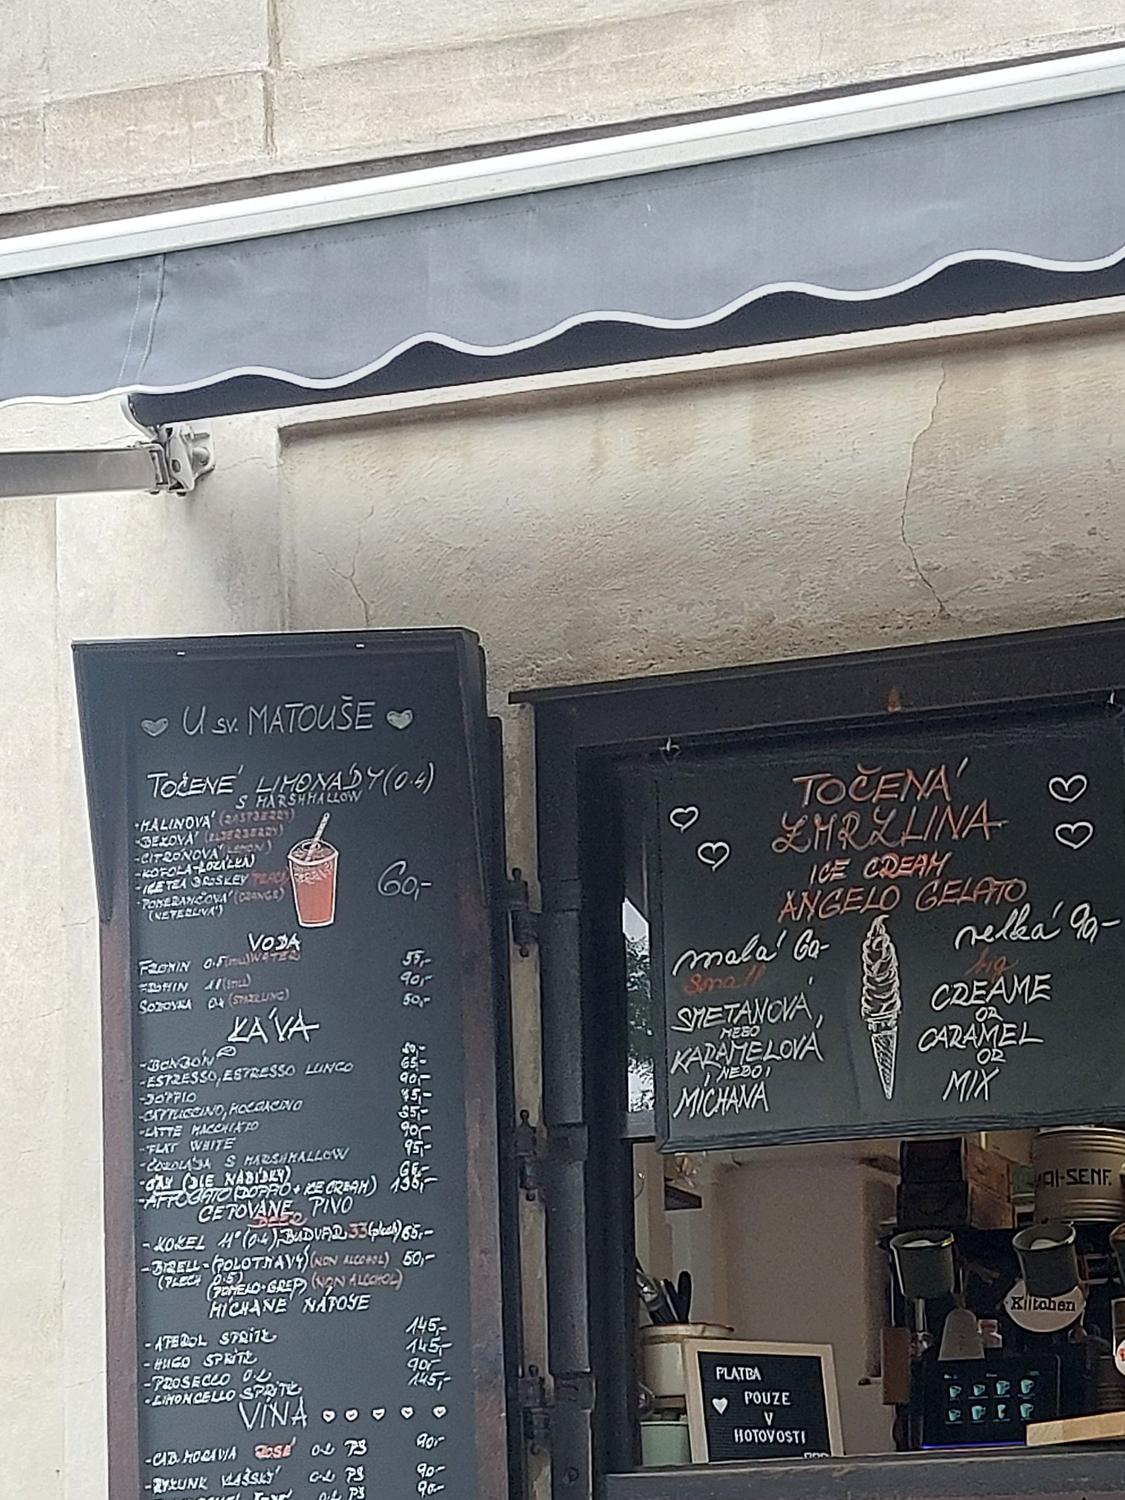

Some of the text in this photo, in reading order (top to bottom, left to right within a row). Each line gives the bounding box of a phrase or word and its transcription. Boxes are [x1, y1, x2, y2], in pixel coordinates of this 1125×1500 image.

[183, 706, 206, 735] U
[249, 695, 375, 735] MATOUŠE
[792, 757, 968, 807] TOČENÁ
[236, 794, 246, 810] S
[772, 799, 1009, 853] ZMRZLINA
[810, 851, 952, 885] ICE CREAM
[778, 877, 1027, 923] ANGELO GELATO
[248, 933, 302, 951] VODA
[931, 973, 1053, 1012] CREAME
[976, 1006, 1003, 1022] OR
[228, 1008, 320, 1044] KÁVA
[917, 1024, 1045, 1052] CARAMEL
[976, 1048, 1006, 1065] OR
[942, 1067, 1000, 1102] MIX
[190, 1139, 235, 1152] WHITE
[310, 1197, 352, 1216] PIVO
[154, 1356, 190, 1370] HUGO
[153, 1374, 231, 1389] PROSECCO
[716, 1366, 762, 1381] PLATBA
[744, 1391, 791, 1405] POUZE
[764, 1412, 774, 1426] V
[734, 1428, 806, 1444] HOTOVOSTI
